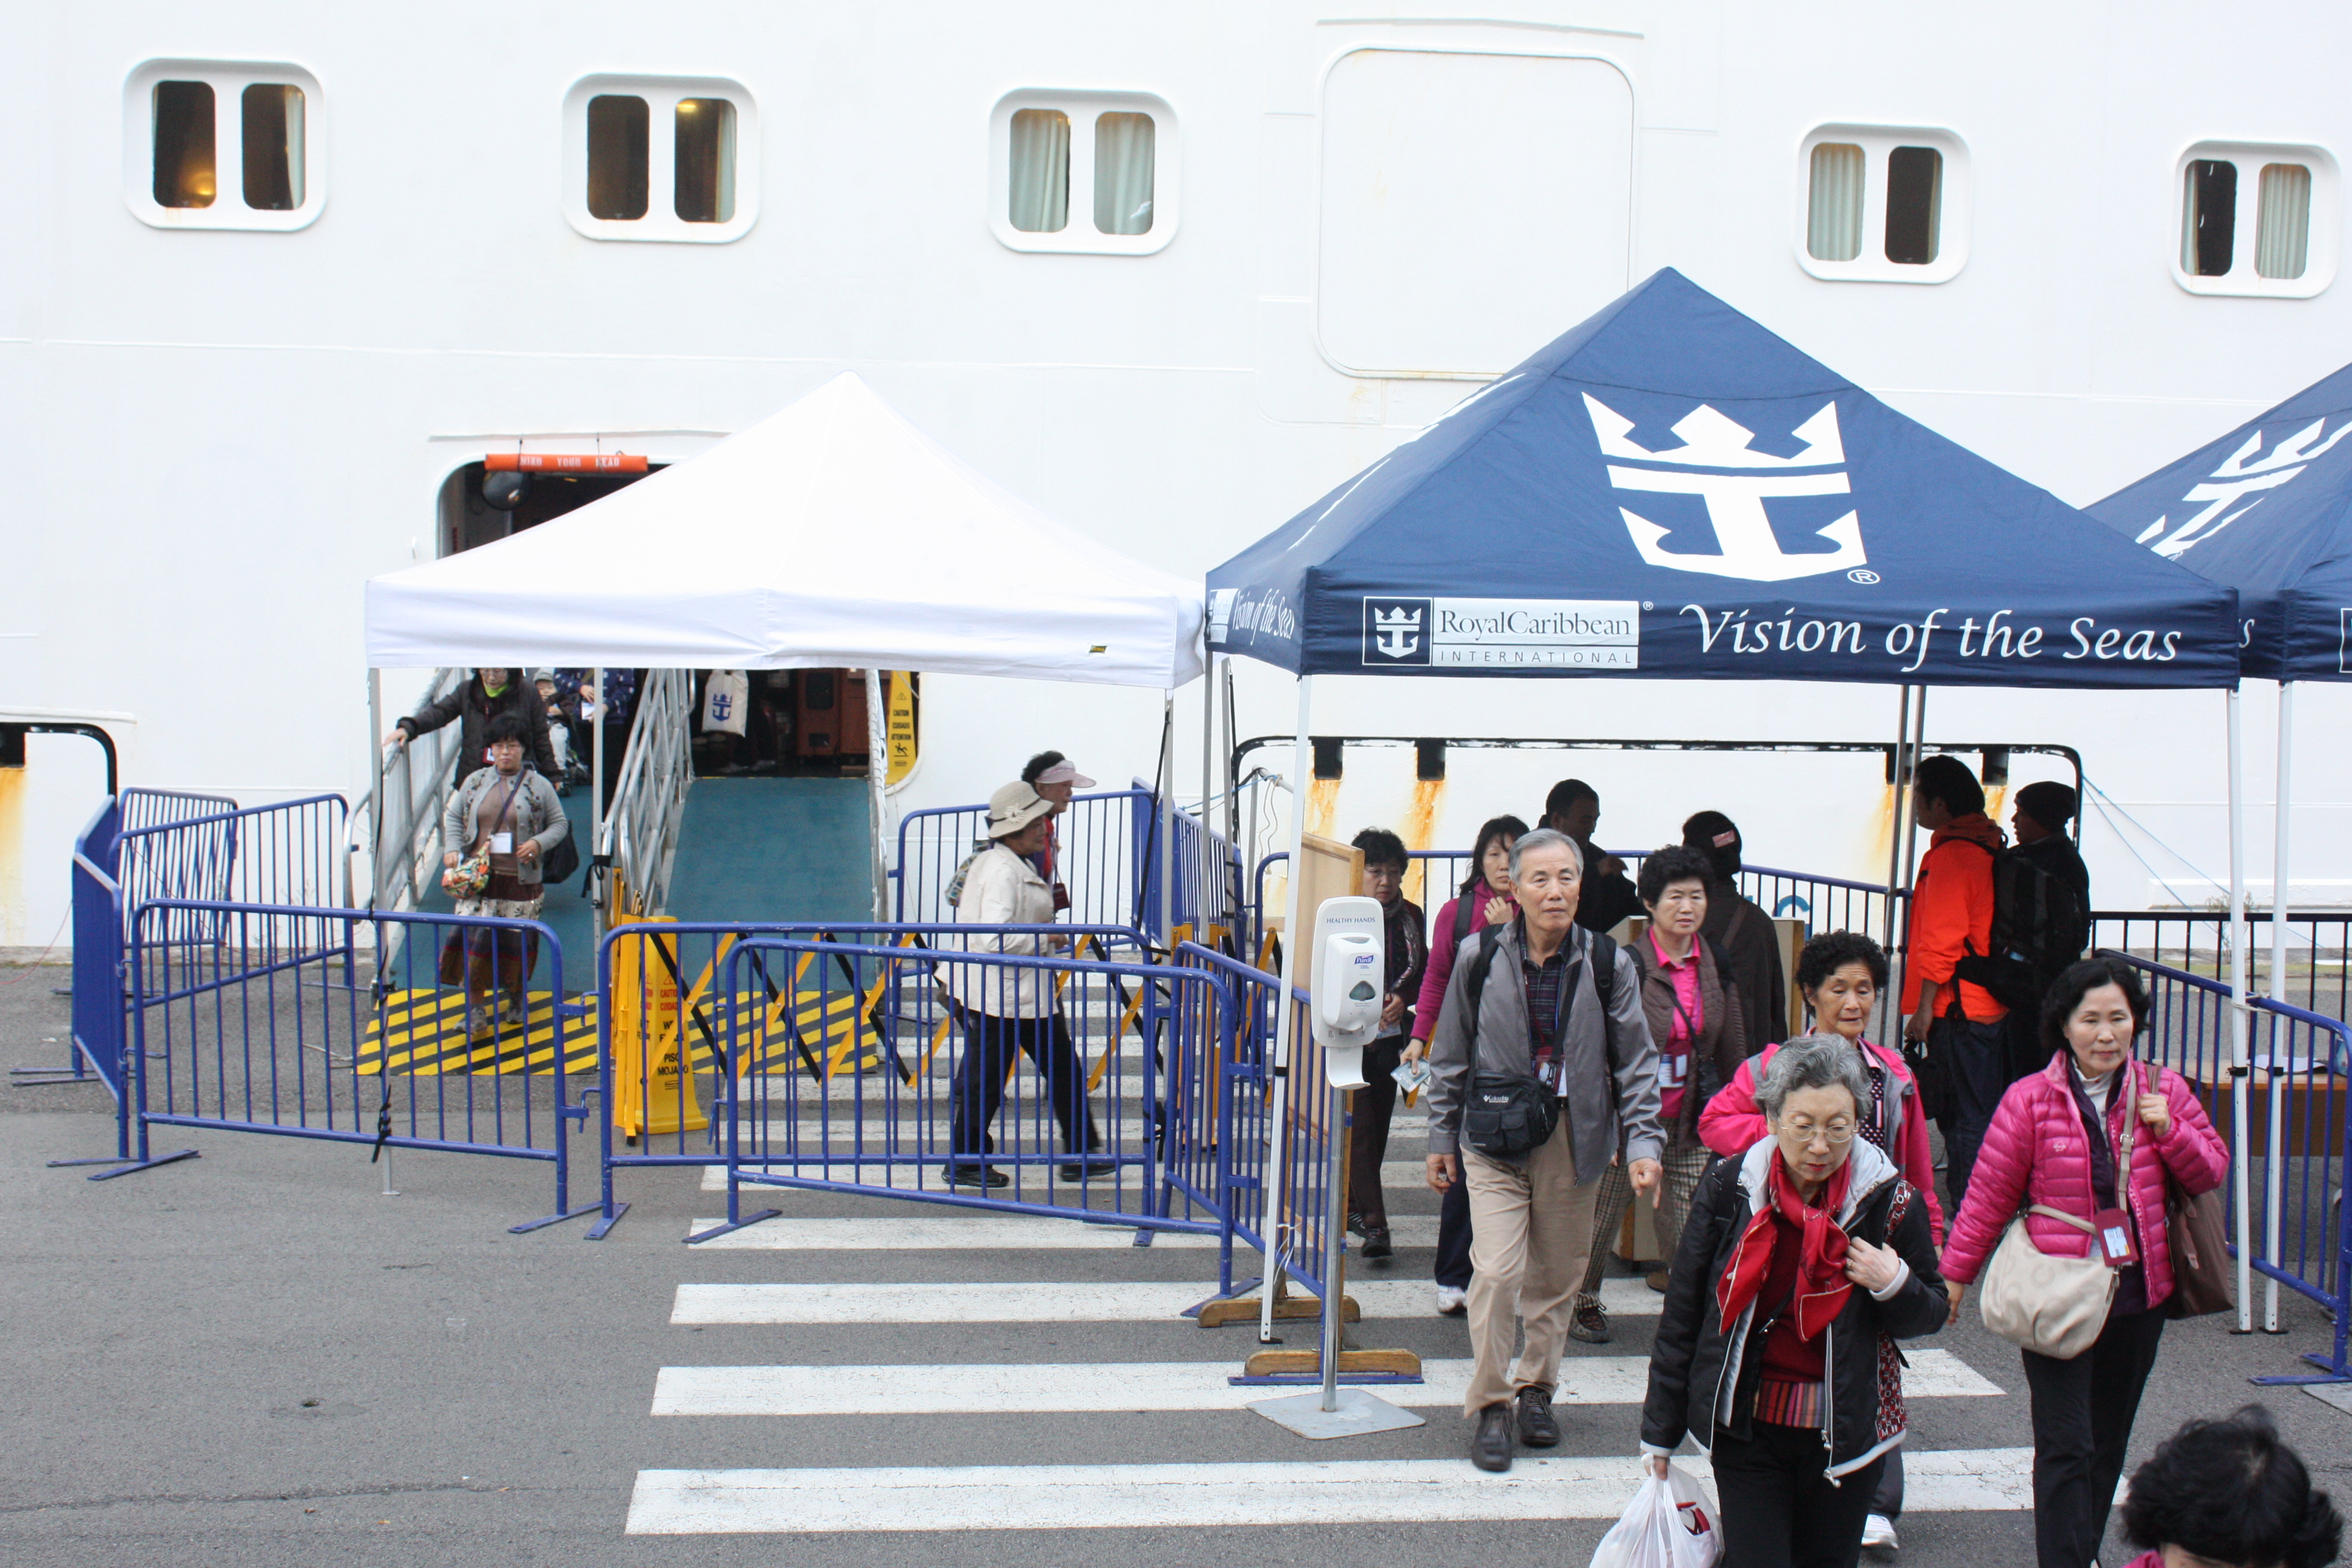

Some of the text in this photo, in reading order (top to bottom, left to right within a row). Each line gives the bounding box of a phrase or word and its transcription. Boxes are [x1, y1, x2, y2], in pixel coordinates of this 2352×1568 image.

[520, 456, 542, 466] MIND
[557, 457, 581, 467] YOUR
[1232, 590, 1255, 630] Vision
[1260, 589, 1280, 633] the
[1679, 604, 1866, 654] Vision
[1885, 608, 1949, 672] of
[1959, 609, 2043, 658] the
[2062, 617, 2181, 661] Seas
[1440, 651, 1631, 663] INTERNATIONAL
[658, 1065, 688, 1076] MOJAO
